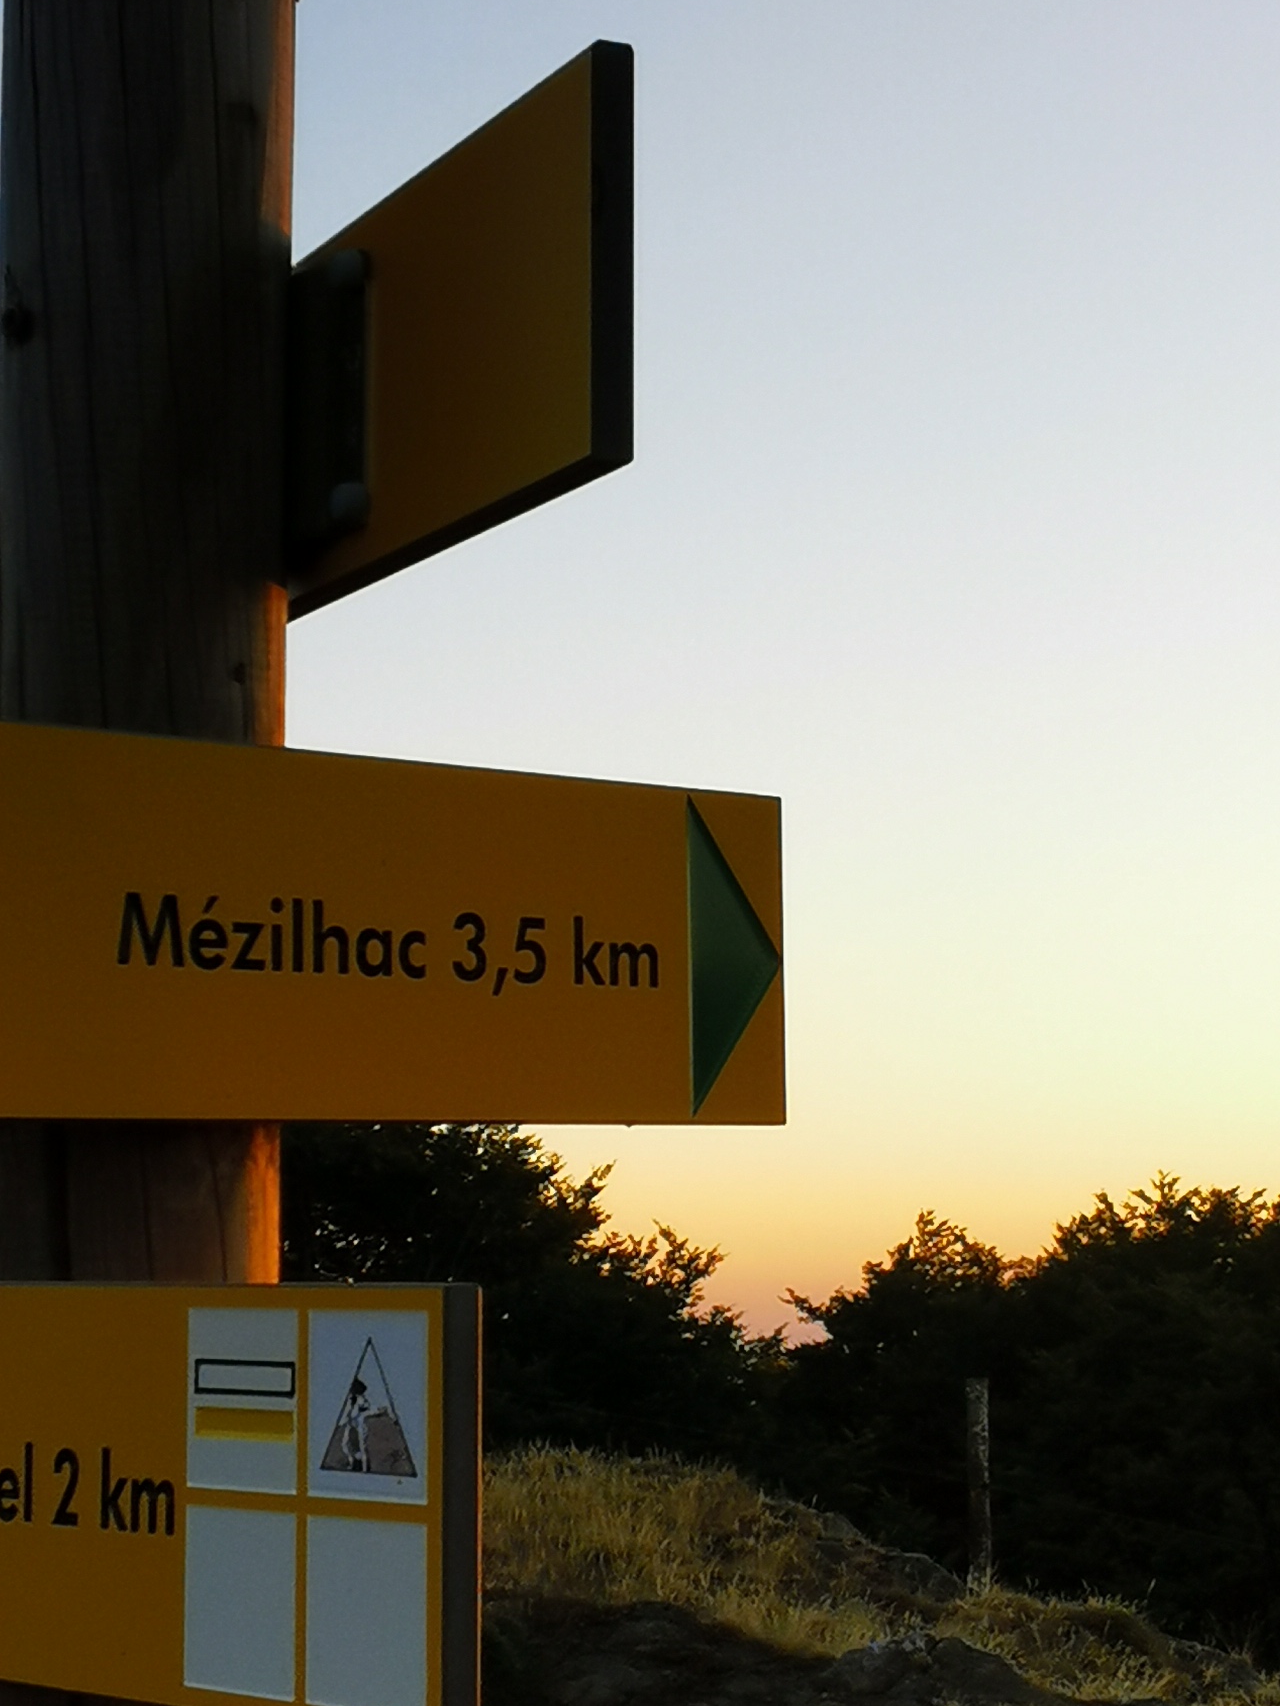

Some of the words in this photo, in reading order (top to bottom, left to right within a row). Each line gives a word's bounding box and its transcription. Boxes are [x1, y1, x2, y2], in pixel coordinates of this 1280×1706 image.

[116, 891, 427, 980] Mézilhac
[452, 911, 547, 997] 3,5
[573, 915, 660, 990] km
[51, 1447, 79, 1527] 2
[100, 1446, 176, 1536] km
